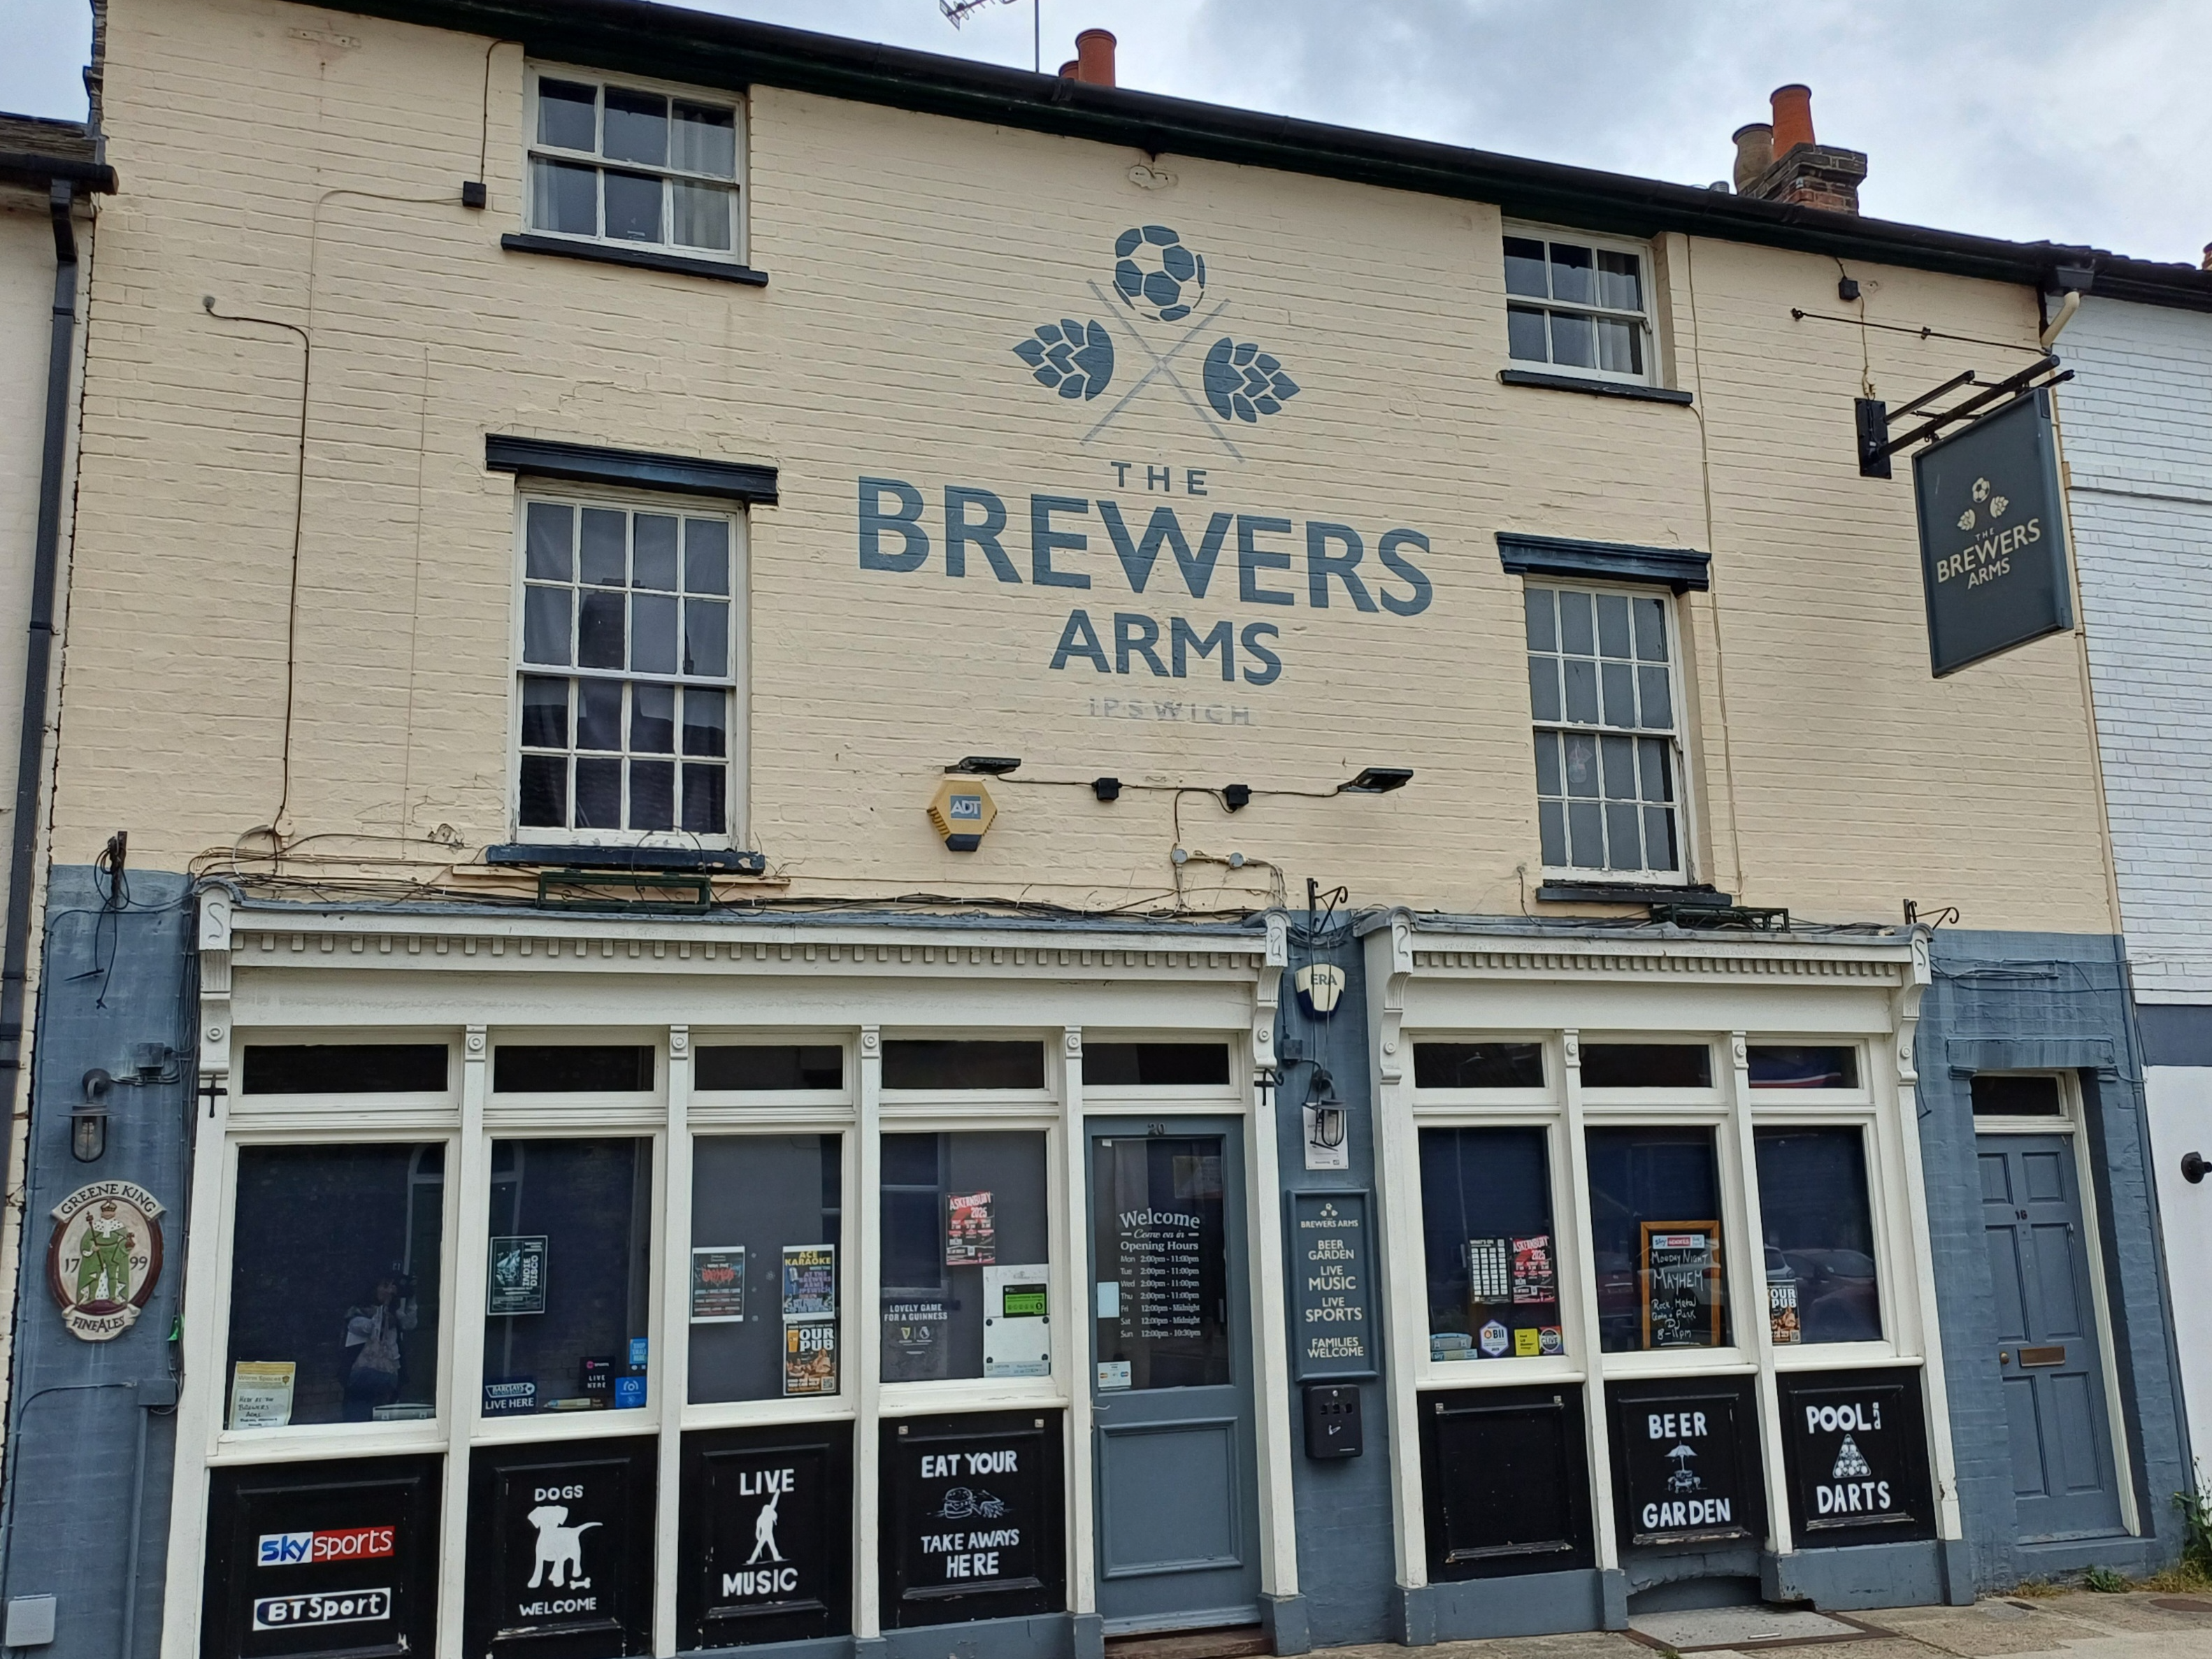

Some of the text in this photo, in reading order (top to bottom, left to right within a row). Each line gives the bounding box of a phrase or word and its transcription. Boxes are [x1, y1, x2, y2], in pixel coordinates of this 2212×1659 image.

[1111, 461, 1208, 496] THE
[1974, 527, 1995, 541] THE
[858, 476, 1432, 616] BREWERS
[1937, 518, 2041, 583] BREWERS
[1967, 557, 2011, 589] ARMS
[1049, 609, 1282, 686] ARMS
[1089, 697, 1249, 726] IPSWICH
[951, 800, 981, 814] ADT
[1311, 973, 1337, 986] ERA
[61, 1184, 156, 1214] GREENE KING
[970, 1207, 987, 1218] 2025
[1119, 1207, 1200, 1229] Welcome
[1120, 1240, 1198, 1253] Opening Hours
[1318, 1240, 1344, 1250] BEER
[784, 1257, 831, 1266] KARAOKE
[1308, 1249, 1354, 1261] GARDEN
[1531, 1250, 1545, 1261] 2025
[64, 1256, 148, 1272] 17 99
[531, 1255, 539, 1286] DISCO
[1320, 1265, 1343, 1276] LIVE
[522, 1258, 531, 1286] INDIE
[1308, 1276, 1356, 1291] MUSIC
[1653, 1268, 1704, 1295] MAYHEM
[1770, 1288, 1796, 1299] OUR
[890, 1304, 919, 1312] LOVELY
[1121, 1305, 1129, 1313] Fri
[1322, 1297, 1345, 1307] LIVE
[1771, 1298, 1797, 1309] PUB
[909, 1312, 947, 1321] GUINNESS
[1120, 1317, 1131, 1326] Sat
[1305, 1307, 1363, 1322] SPORTS
[799, 1328, 834, 1340] OUR
[1120, 1330, 1133, 1338] Sun
[800, 1340, 833, 1352] PUB
[1312, 1337, 1359, 1348] FAMILIES
[1307, 1346, 1364, 1358] WELCOME
[485, 1398, 534, 1409] LIVE HERE
[1648, 1412, 1708, 1439] BEER
[1806, 1403, 1872, 1434] POOL
[921, 1450, 1019, 1479] EAT YOUR
[740, 1469, 795, 1495] LIVE
[534, 1485, 584, 1502] DOGS
[1816, 1481, 1891, 1514] DARTS
[1642, 1498, 1731, 1528] GARDEN
[261, 1529, 394, 1563] sky sports
[921, 1529, 1020, 1554] TAKE AWAYS
[946, 1551, 1000, 1579] HERE
[722, 1567, 798, 1597] MUSIC
[268, 1593, 381, 1622] BT Sport
[519, 1597, 596, 1617] WELCOME
